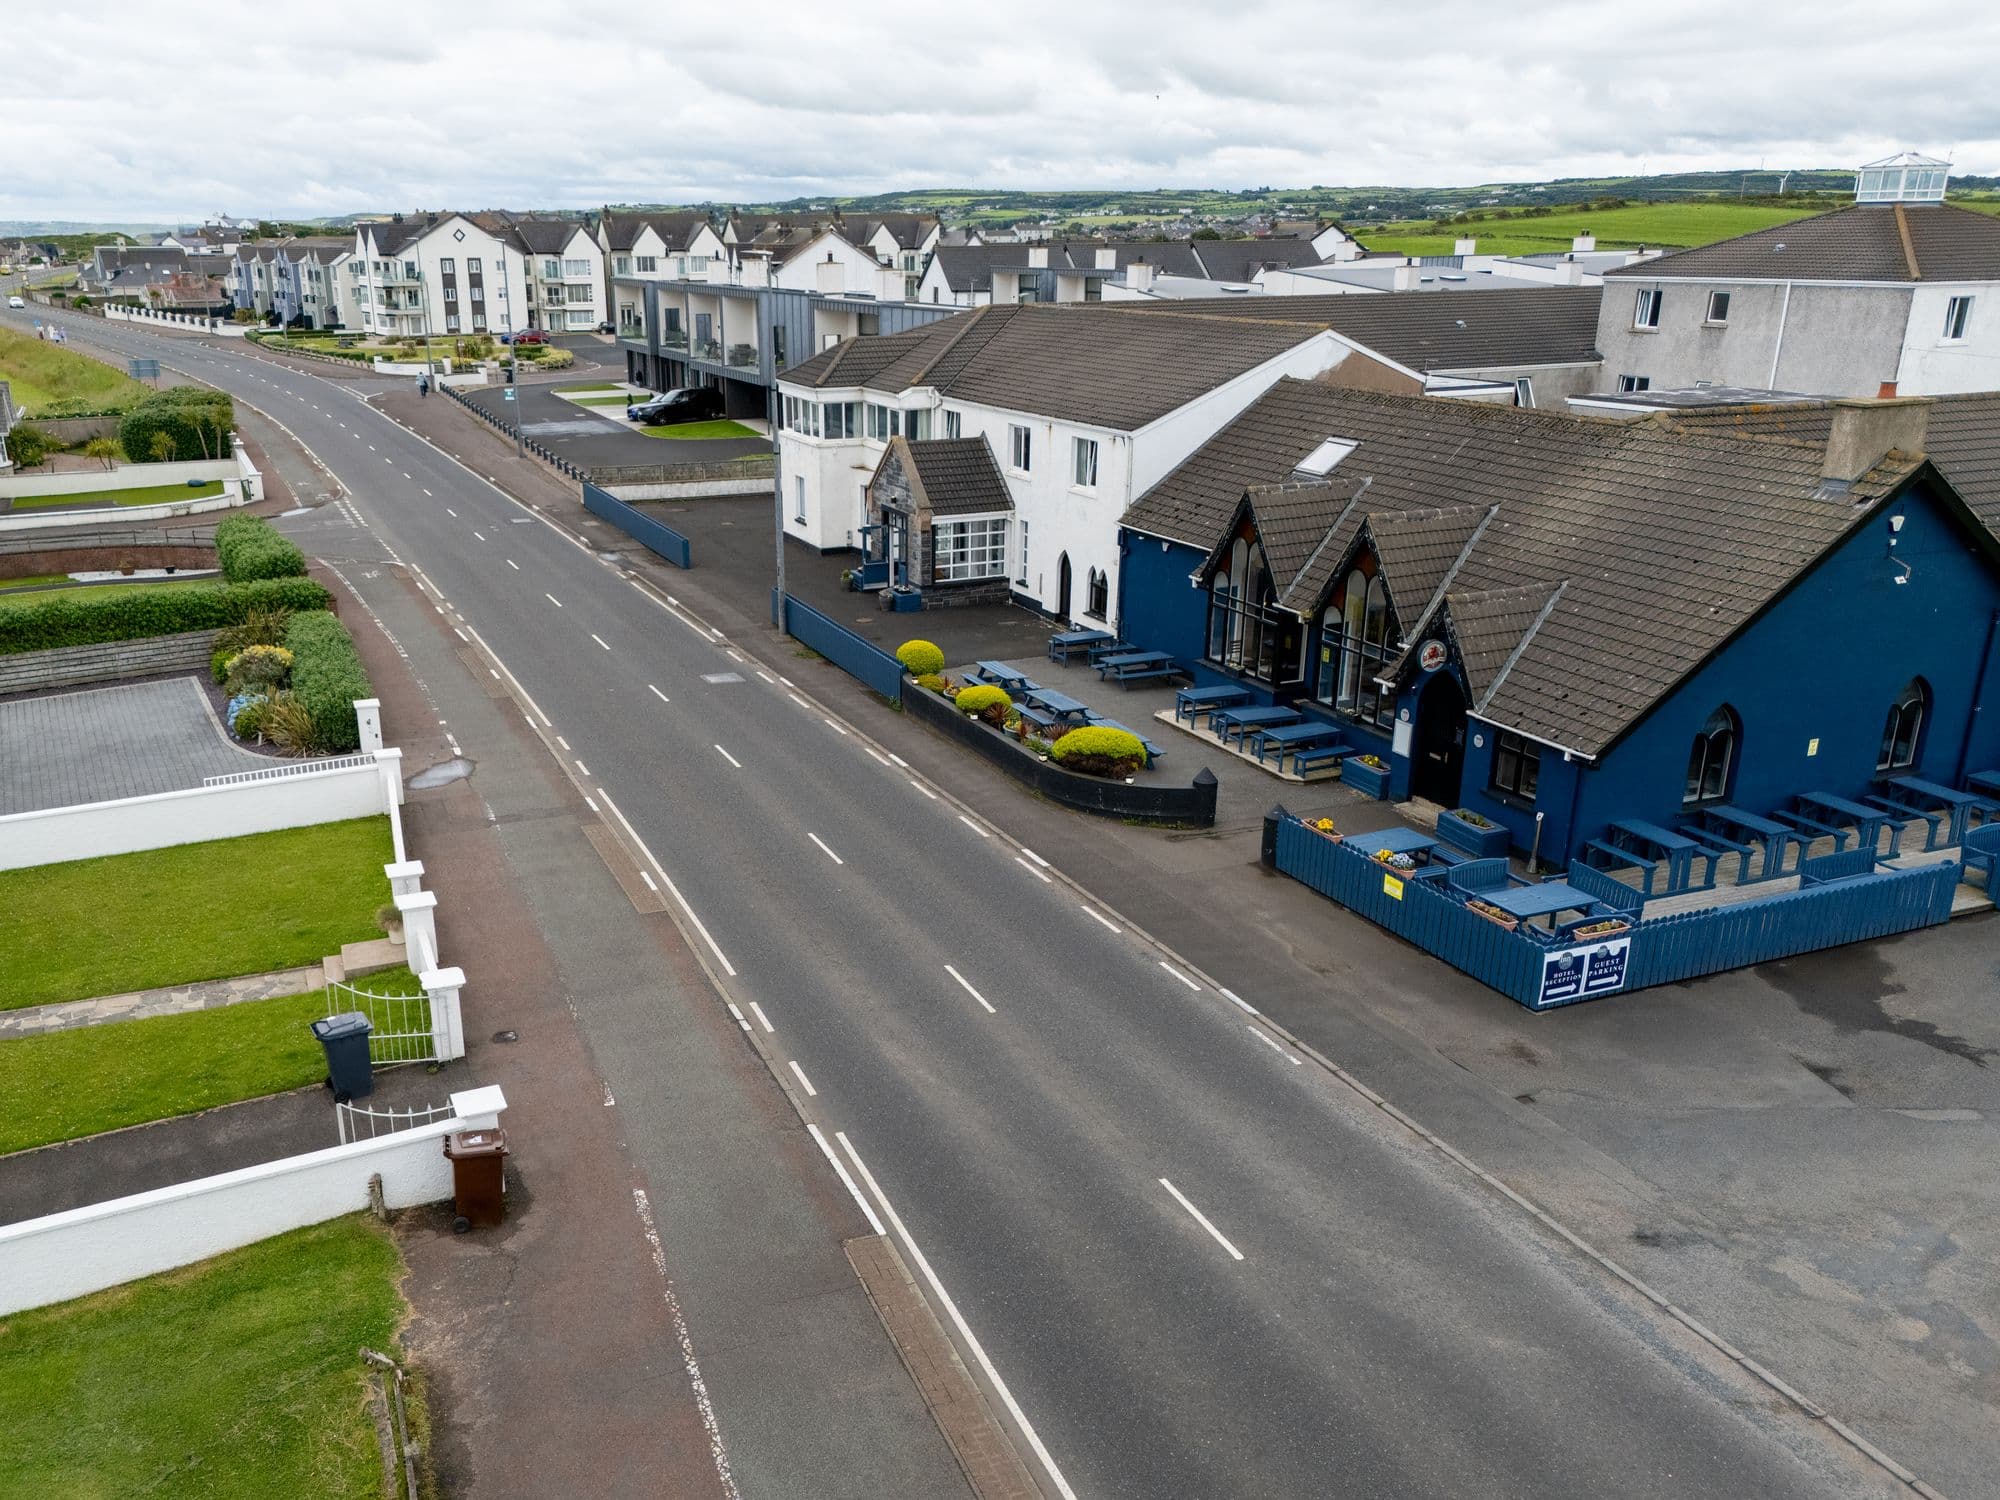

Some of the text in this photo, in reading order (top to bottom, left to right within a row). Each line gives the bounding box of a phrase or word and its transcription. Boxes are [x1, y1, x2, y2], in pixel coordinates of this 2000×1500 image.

[1594, 958, 1620, 969] GUEST
[1553, 969, 1575, 979] HOTEL
[1588, 964, 1624, 977] PARKING
[1545, 974, 1582, 986] RECEPTION
